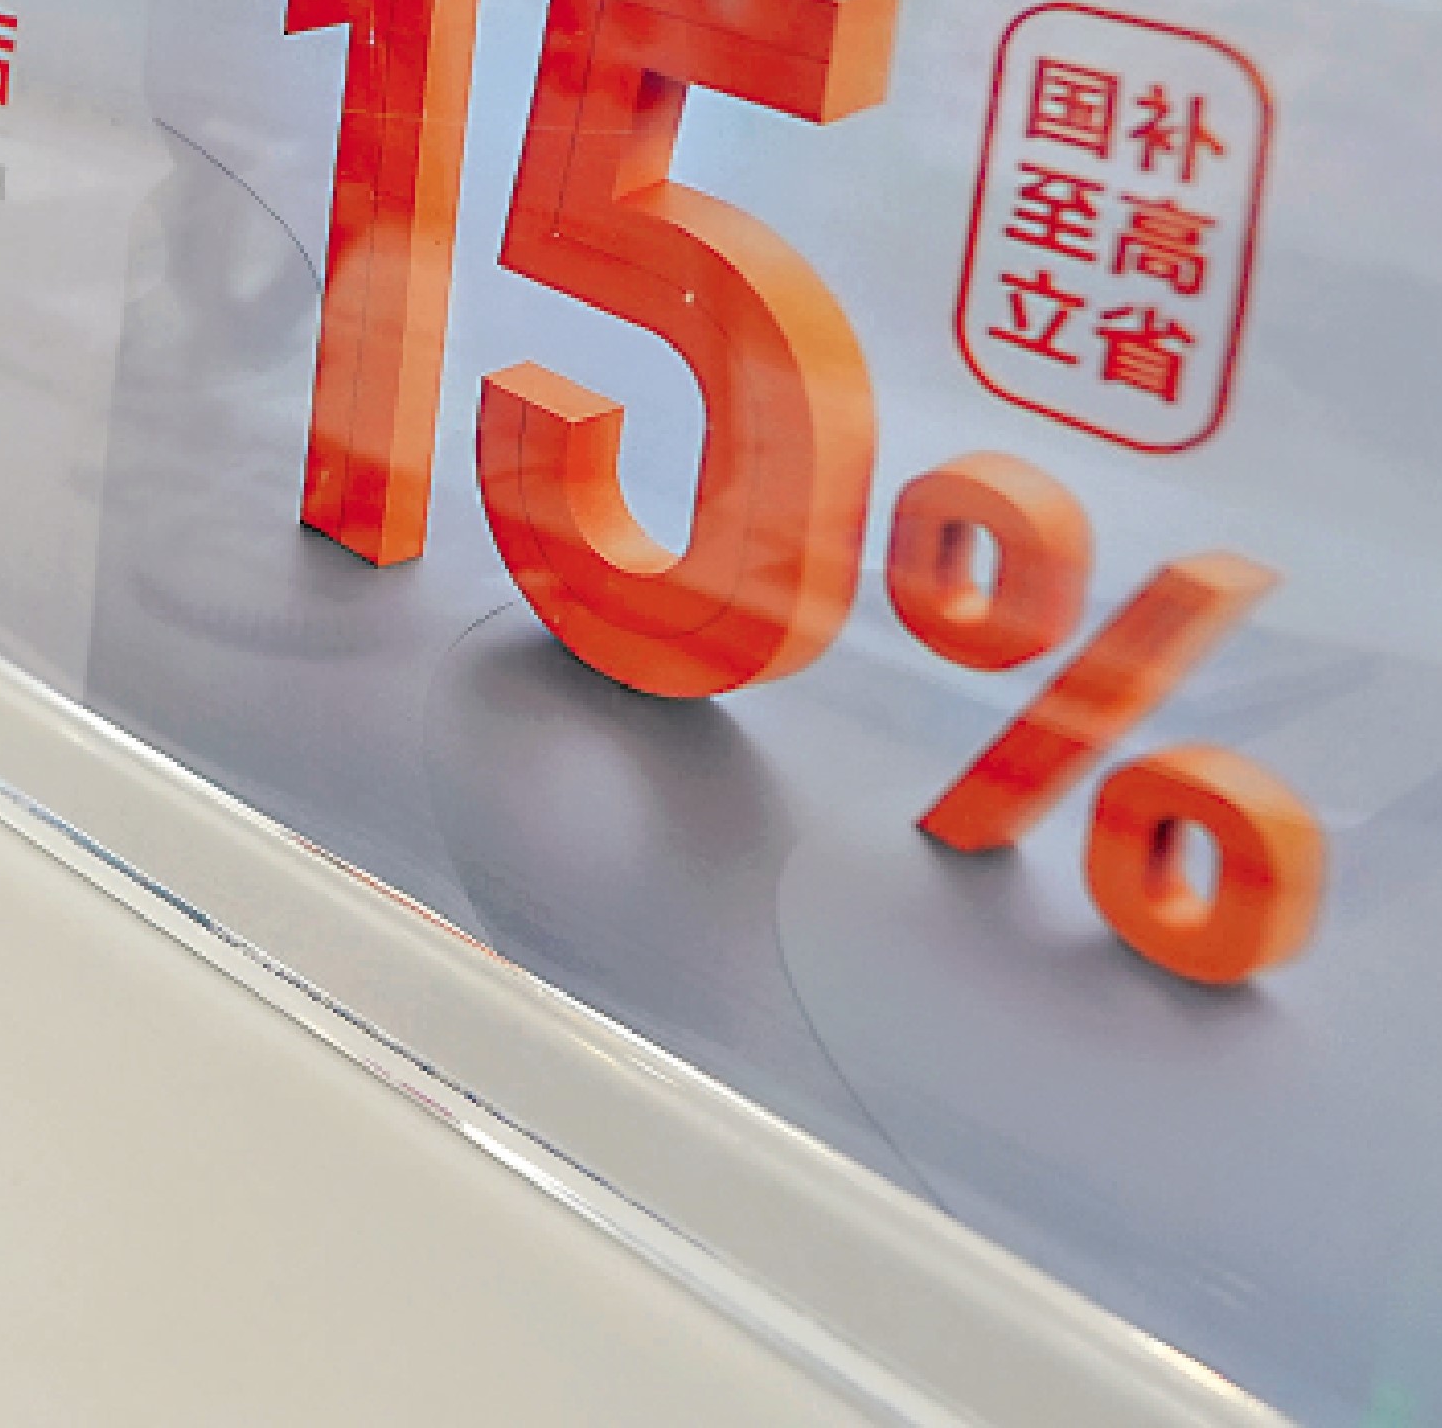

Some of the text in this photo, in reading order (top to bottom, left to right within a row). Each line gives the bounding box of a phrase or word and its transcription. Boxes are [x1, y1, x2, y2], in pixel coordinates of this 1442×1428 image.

[1026, 56, 1225, 184] 国补
[1004, 162, 1216, 295] 至高
[988, 271, 1196, 403] 立省
